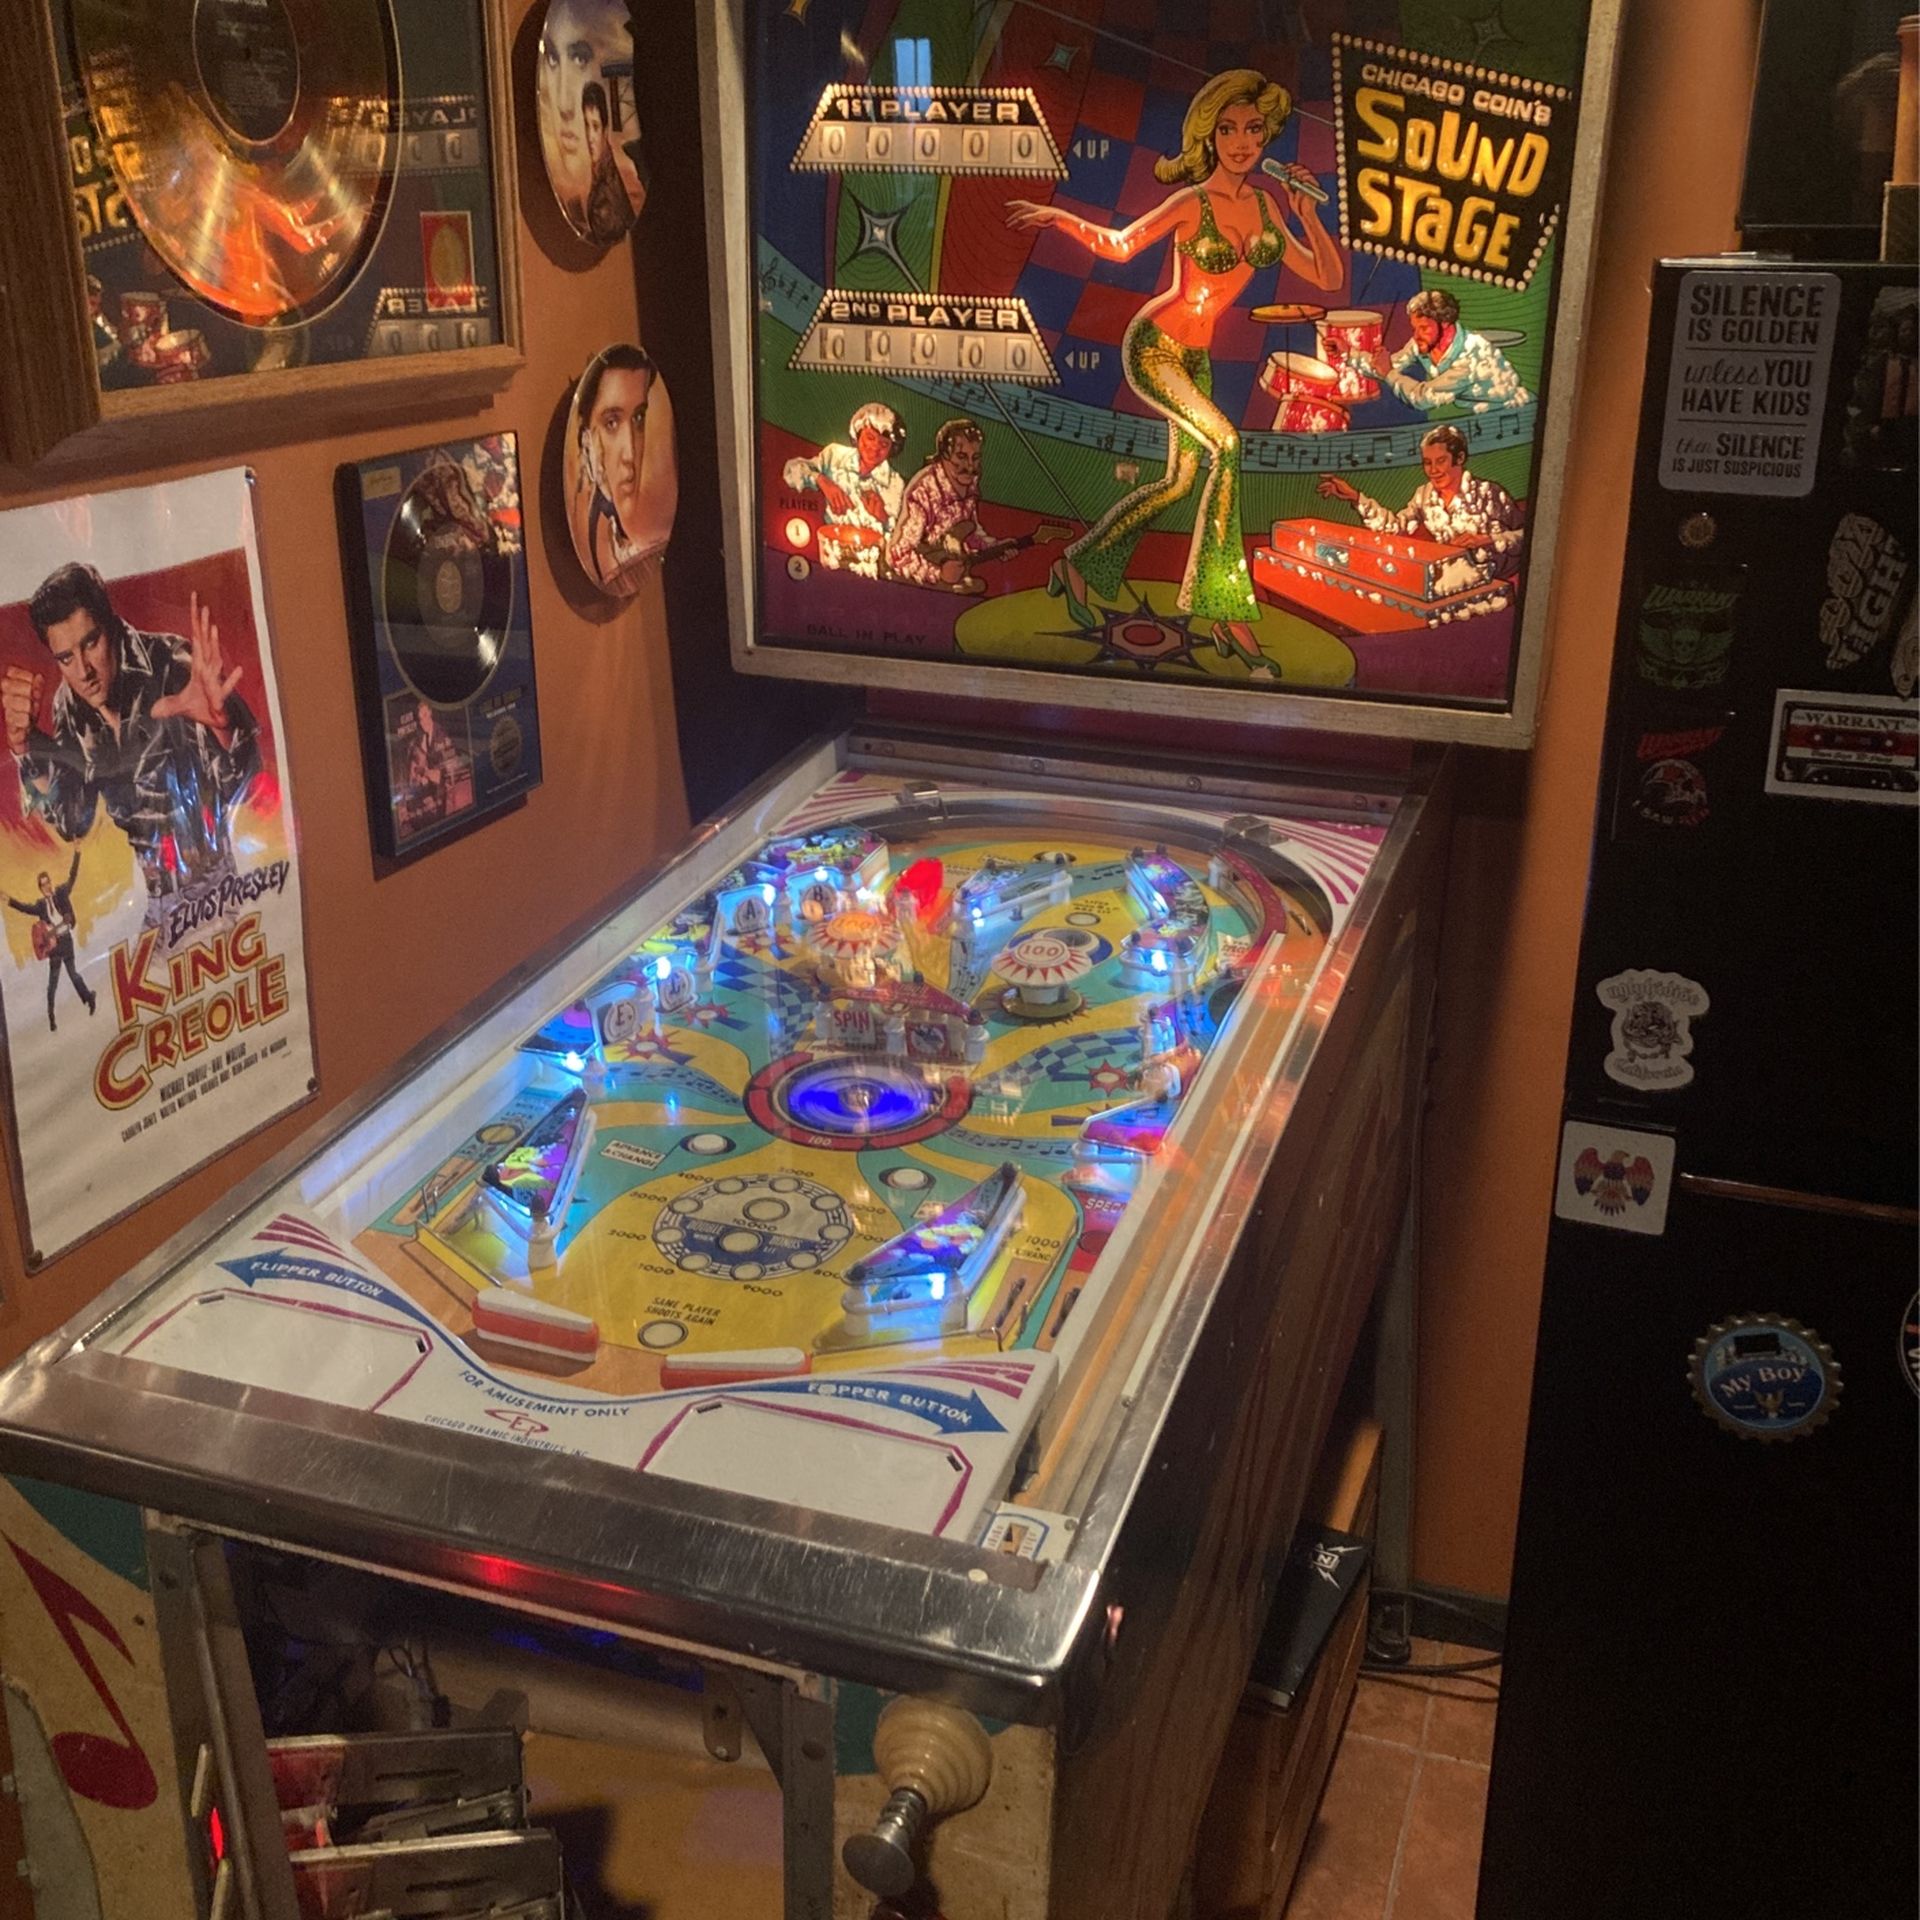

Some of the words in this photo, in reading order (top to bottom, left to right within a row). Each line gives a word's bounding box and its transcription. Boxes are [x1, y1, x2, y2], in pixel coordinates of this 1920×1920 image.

[1361, 63, 1466, 105] CHICAGO
[1472, 90, 1552, 126] COIN'S
[880, 100, 1020, 124] PLAYER
[1087, 139, 1110, 160] UP
[1355, 86, 1550, 198] SOUND
[1690, 284, 1827, 318] SILENCE
[830, 302, 880, 321] 2ND
[887, 304, 1019, 330] PLAYER
[1687, 318, 1711, 342] IS
[1721, 318, 1818, 345] GOLDEN
[1078, 351, 1100, 371] UP
[1684, 358, 1762, 385] unless
[1763, 359, 1813, 388] YOU
[1680, 387, 1744, 414] HAVE
[1751, 390, 1812, 417] KIDS
[1716, 433, 1806, 460] SILENCE
[1672, 458, 1685, 473] IS
[1688, 458, 1721, 474] JUST
[1723, 460, 1802, 478] SUSPICIOUS
[856, 629, 874, 641] IN
[883, 631, 927, 645] PLAY
[1804, 711, 1906, 731] WARRANT
[167, 888, 220, 948] ELVIS
[217, 860, 290, 917] PRESLEY
[1023, 945, 1060, 957] 100
[109, 911, 268, 1031] KING
[94, 953, 290, 1111] CREOLE
[833, 1010, 870, 1031] SPIN
[808, 1136, 832, 1147] 100
[1026, 1235, 1061, 1249] 1000
[250, 1261, 321, 1278] FLIPPER
[324, 1271, 384, 1298] BUTTON
[682, 1302, 721, 1317] PLAYER
[458, 1369, 484, 1388] FOR
[485, 1387, 579, 1417] AMUSEMENT
[584, 1407, 631, 1418] ONLY
[1720, 1374, 1751, 1399] My
[1758, 1366, 1808, 1383] Boy
[807, 1383, 891, 1401] FPPER
[899, 1393, 973, 1426] BUTTON
[424, 1414, 466, 1430] CHICAGO
[466, 1424, 510, 1441] DYNAMIC
